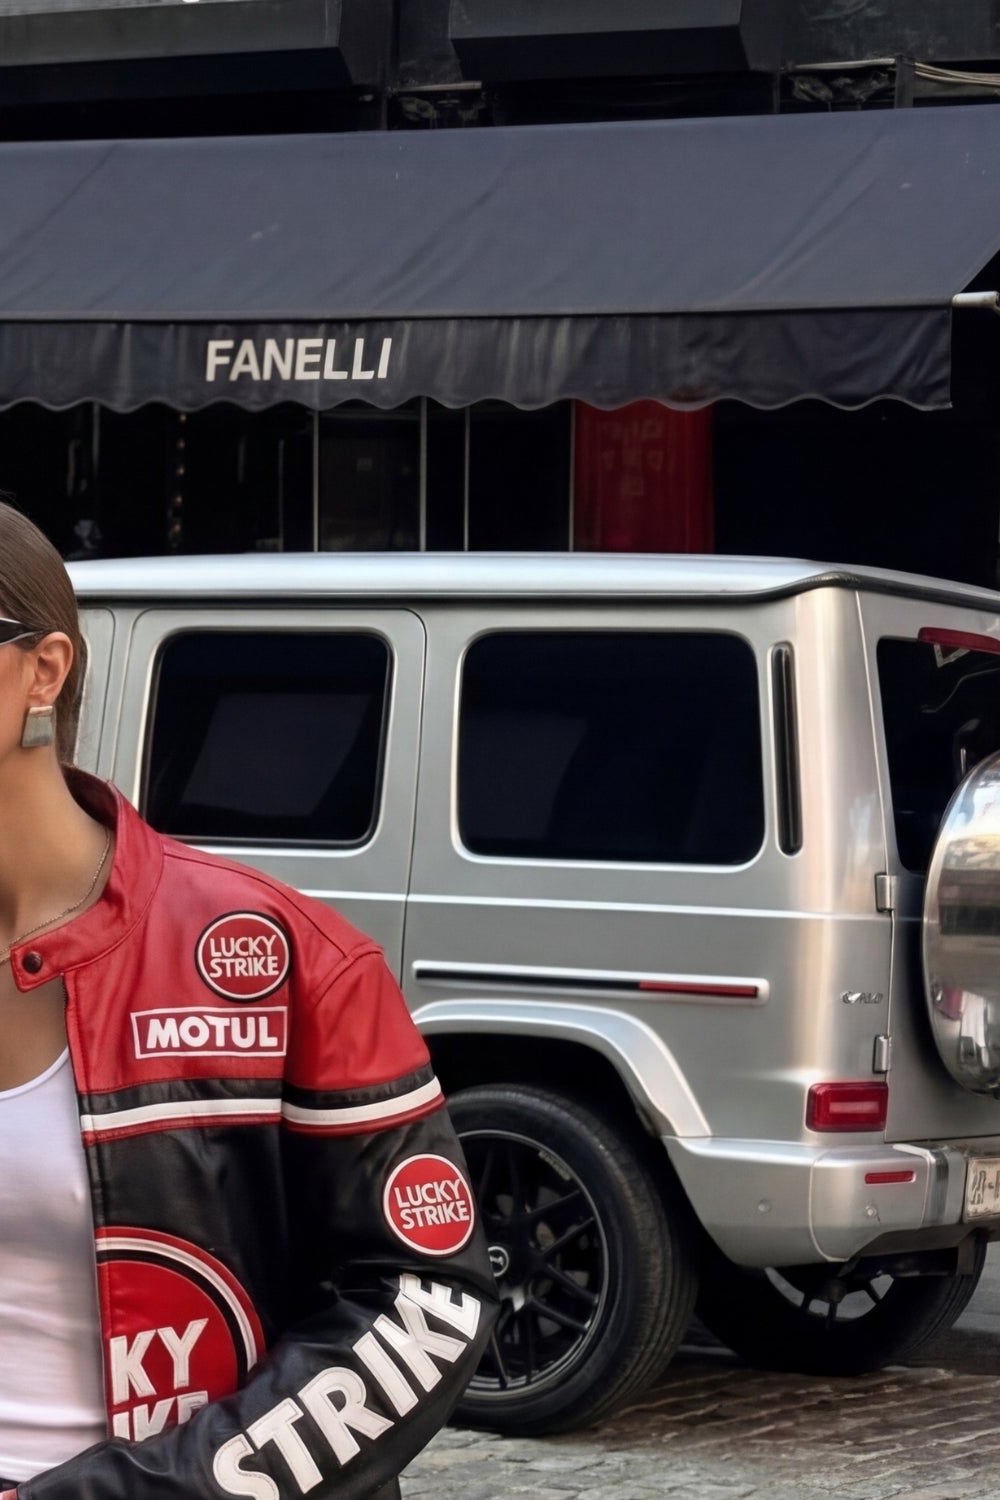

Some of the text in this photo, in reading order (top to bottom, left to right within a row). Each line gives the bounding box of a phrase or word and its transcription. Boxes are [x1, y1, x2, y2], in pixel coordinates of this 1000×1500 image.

[205, 337, 393, 382] FANELLI
[210, 934, 276, 958] LUCKY
[209, 957, 279, 979] STRIKE
[146, 1014, 278, 1049] MOTUL
[393, 1178, 462, 1208] LUCKY
[399, 1201, 470, 1230] STRIKE
[109, 1317, 209, 1406] KY
